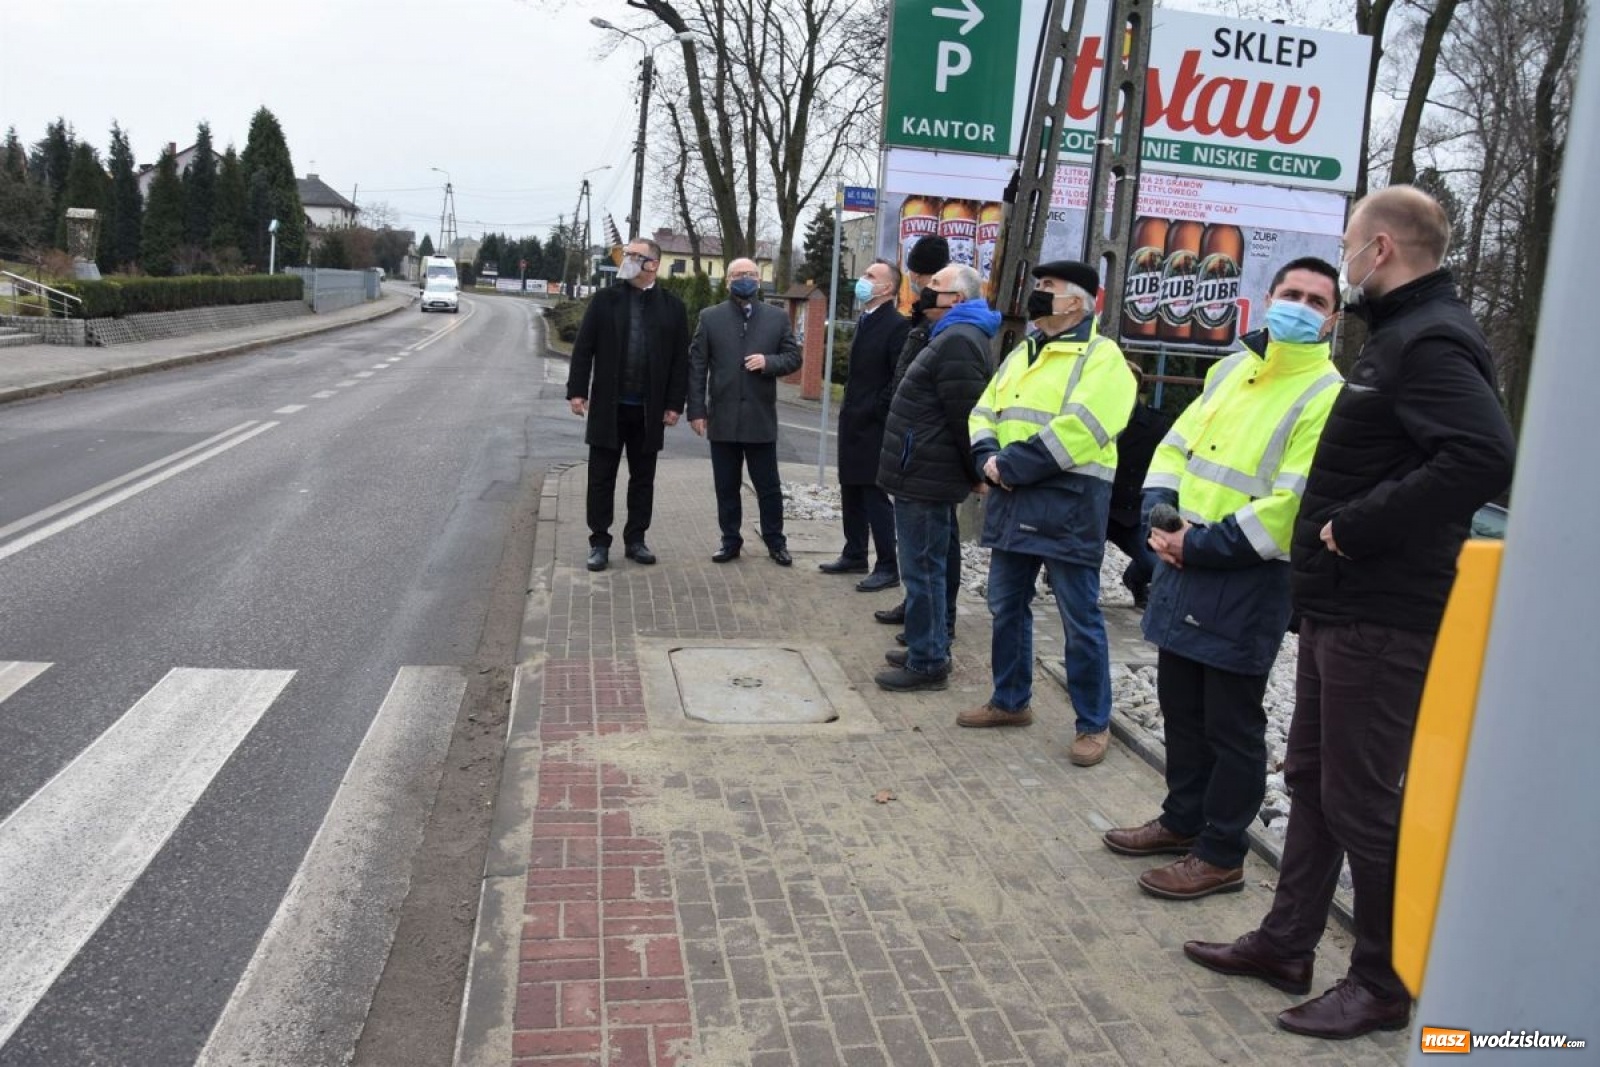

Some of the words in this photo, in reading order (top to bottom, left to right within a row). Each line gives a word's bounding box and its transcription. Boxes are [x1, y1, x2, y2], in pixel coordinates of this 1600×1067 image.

[1211, 26, 1317, 68] SKLEP
[935, 40, 972, 93] P
[902, 116, 996, 142] KANTOR
[1192, 146, 1258, 169] NISKIE
[1268, 154, 1321, 176] CENY
[1205, 203, 1213, 211] W
